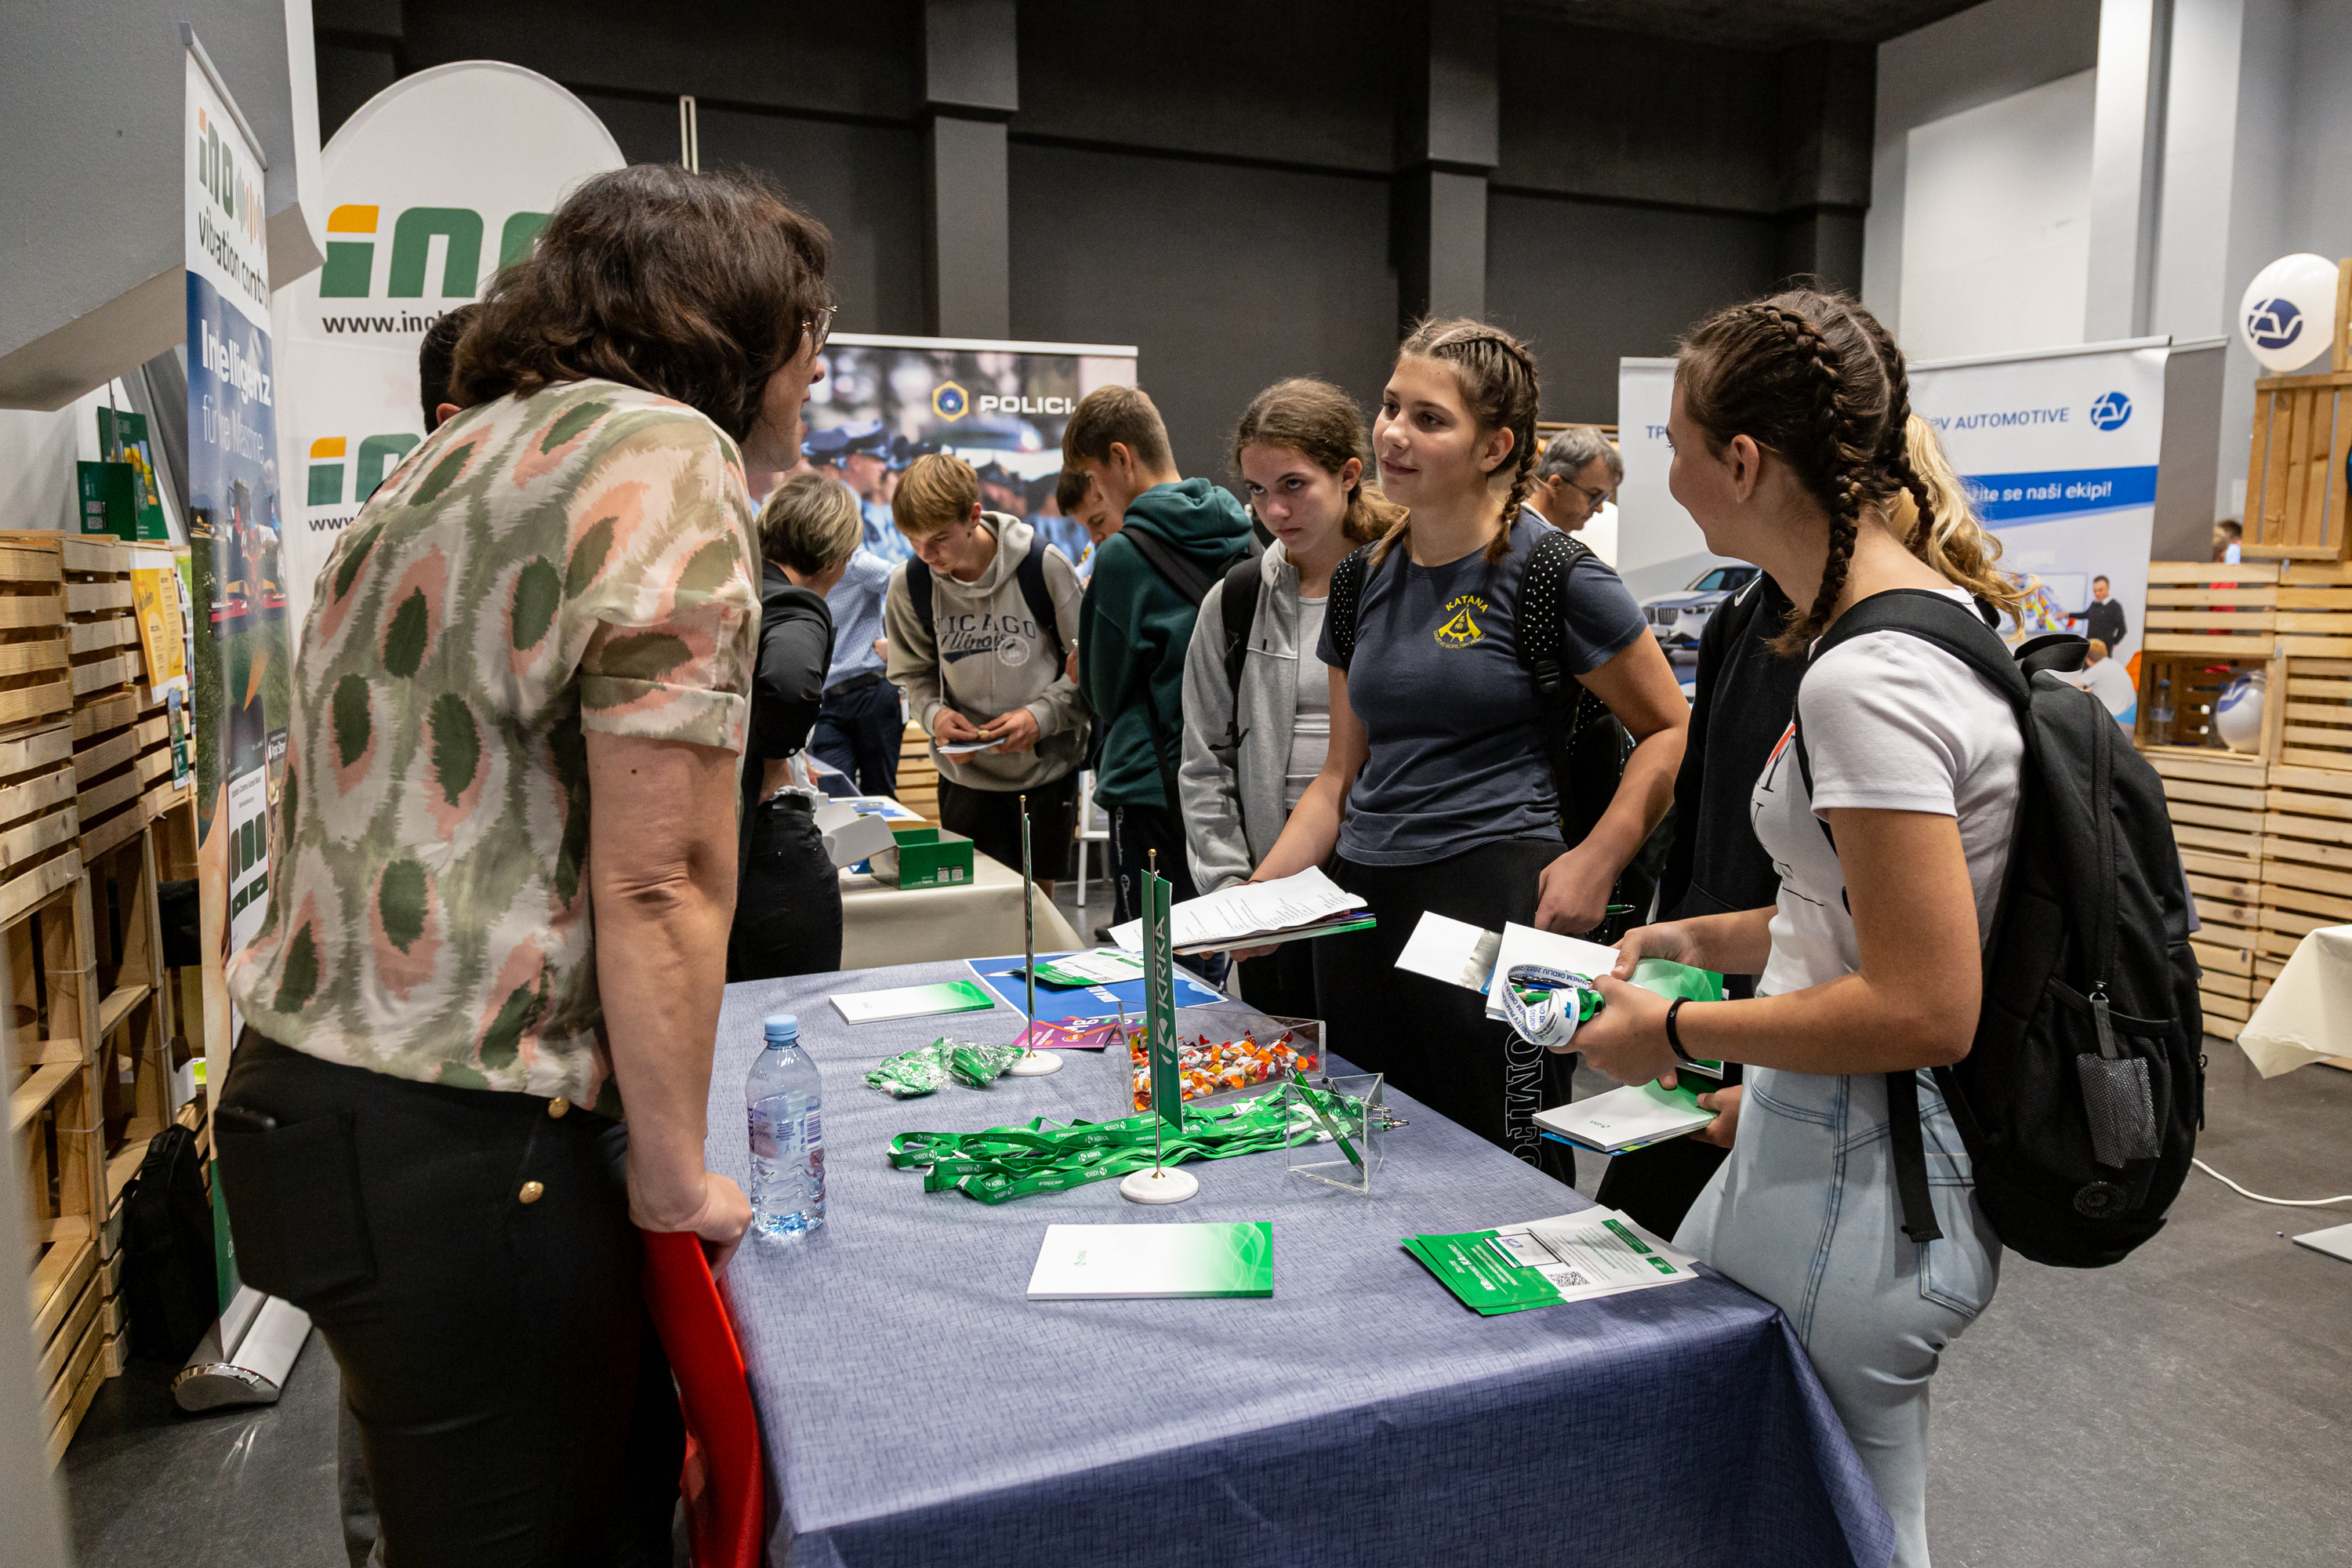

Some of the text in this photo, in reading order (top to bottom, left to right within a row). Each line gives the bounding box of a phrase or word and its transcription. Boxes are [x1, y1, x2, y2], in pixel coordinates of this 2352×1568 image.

[199, 205, 268, 311] vibration contr
[322, 310, 443, 333] www.ino
[201, 319, 272, 407] Intelligenz
[980, 395, 1076, 415] POLICI
[1955, 407, 2071, 430] AUTOMOTIVE
[2003, 488, 2023, 501] se
[2026, 481, 2062, 501] naši
[2065, 481, 2112, 501] ekipi!
[309, 517, 354, 532] www
[1445, 595, 1489, 613] KATANA
[935, 614, 1036, 639] ICAGO
[1155, 915, 1170, 1010] KRKA
[1542, 968, 1566, 979] OKOLJU
